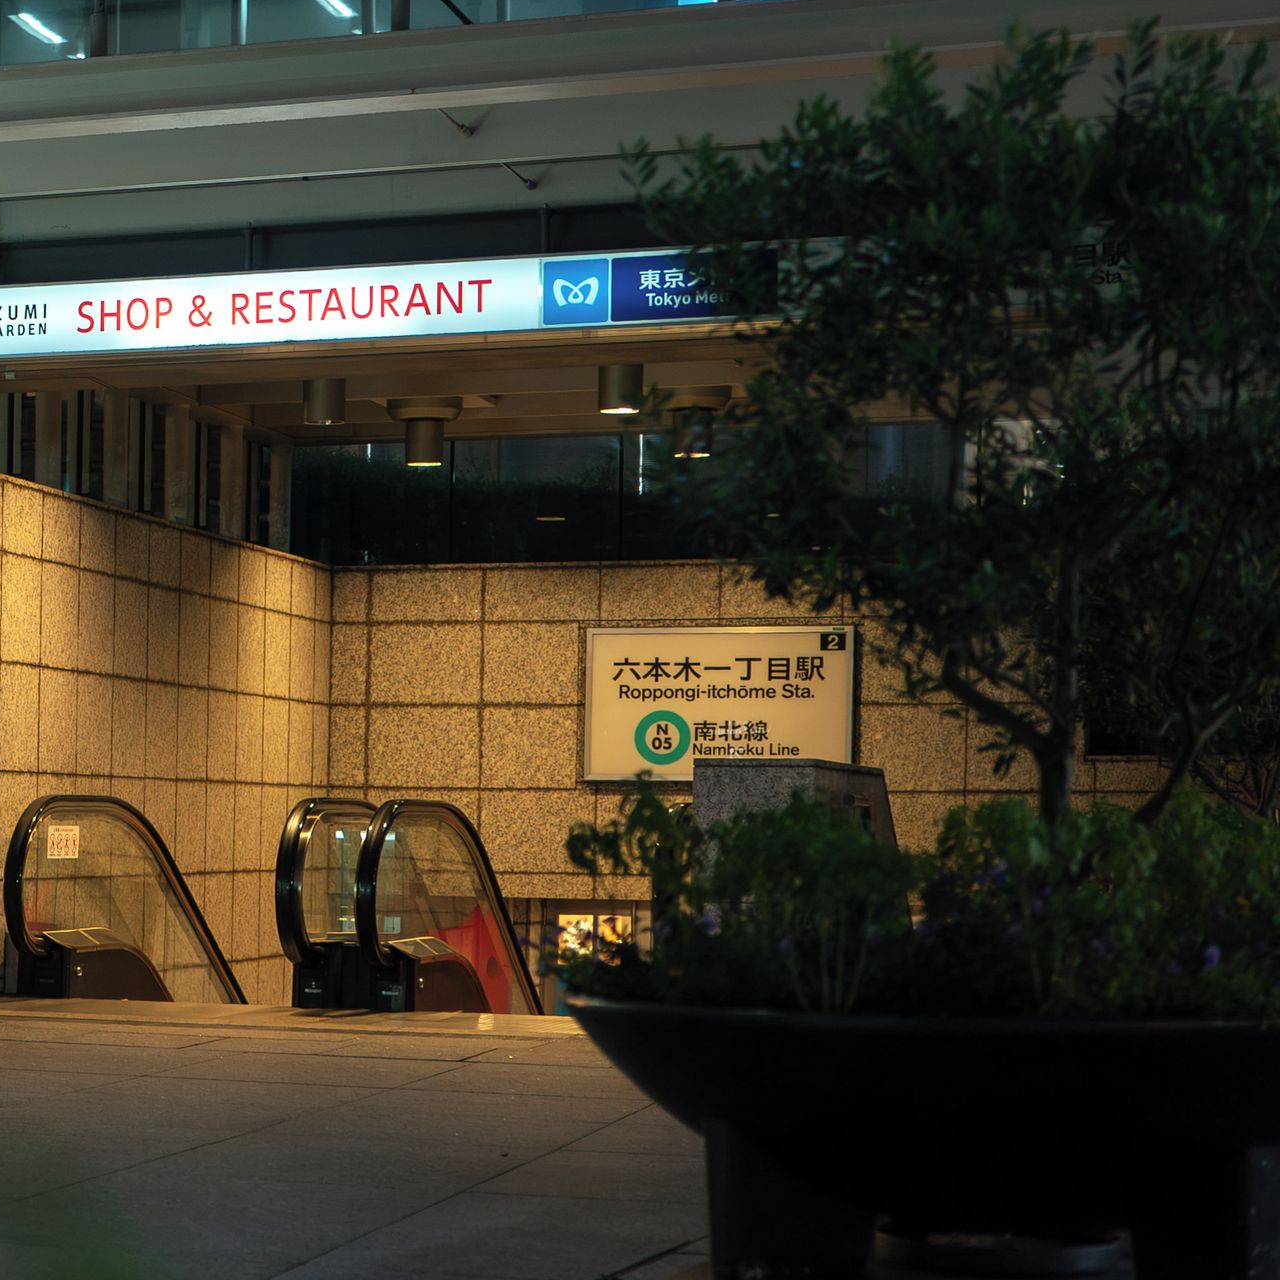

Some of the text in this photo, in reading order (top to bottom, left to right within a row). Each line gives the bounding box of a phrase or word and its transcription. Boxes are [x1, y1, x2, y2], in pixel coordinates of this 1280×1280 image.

[76, 279, 493, 333] SHOP & RESTAURANT
[645, 292, 691, 308] Tokyo
[827, 634, 839, 650] 2
[612, 656, 825, 682] 六本木一丁目駅
[618, 683, 815, 702] Roppongi-itchōme Sta.
[656, 723, 669, 735] N
[693, 720, 769, 742] 南北線
[651, 737, 673, 750] 05
[692, 743, 800, 756] Namboku Line
